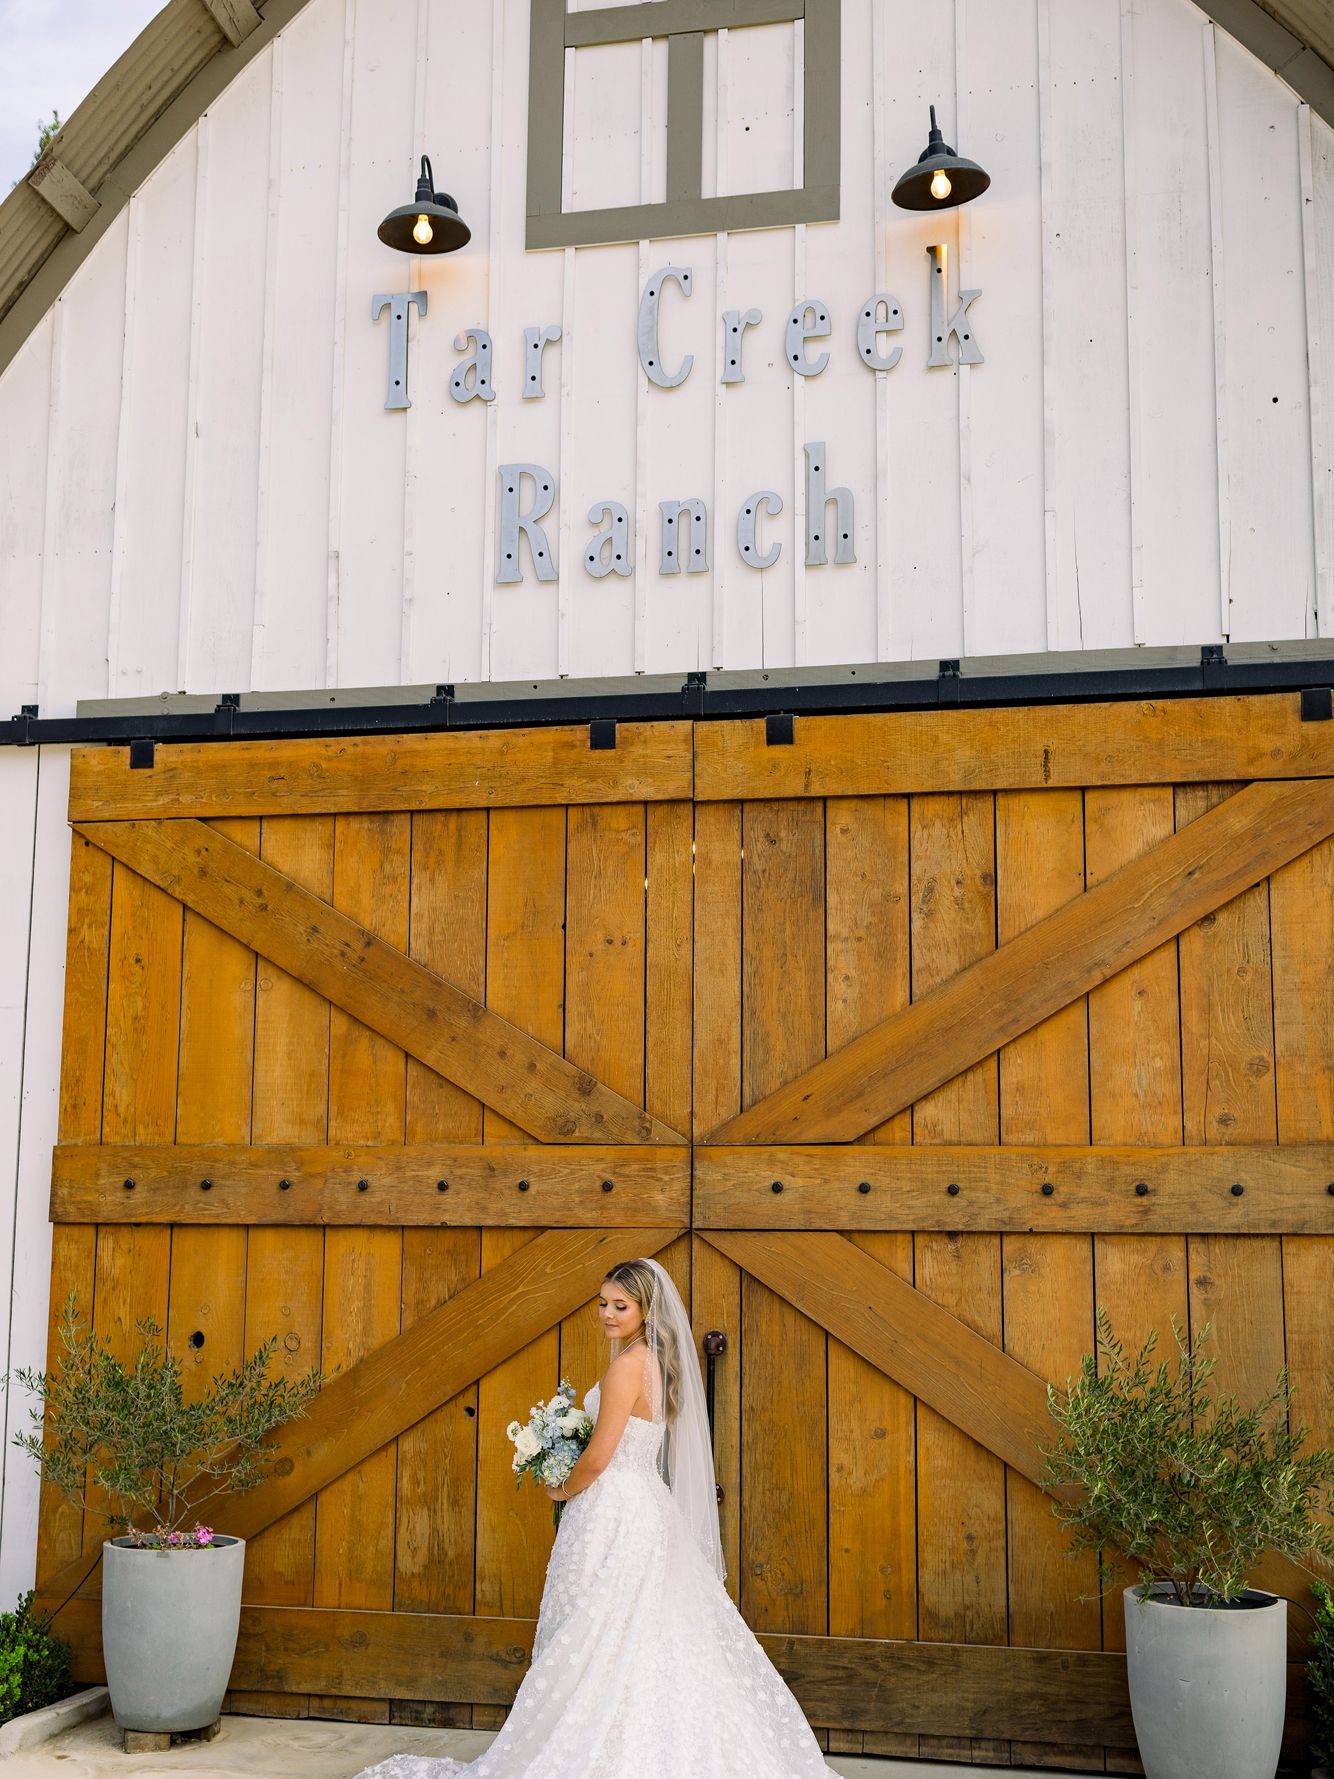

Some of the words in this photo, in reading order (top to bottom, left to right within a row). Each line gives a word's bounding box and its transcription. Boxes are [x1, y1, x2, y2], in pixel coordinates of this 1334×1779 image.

[371, 290, 563, 410] Tar
[637, 243, 985, 389] Creek
[496, 441, 858, 584] Ranch
